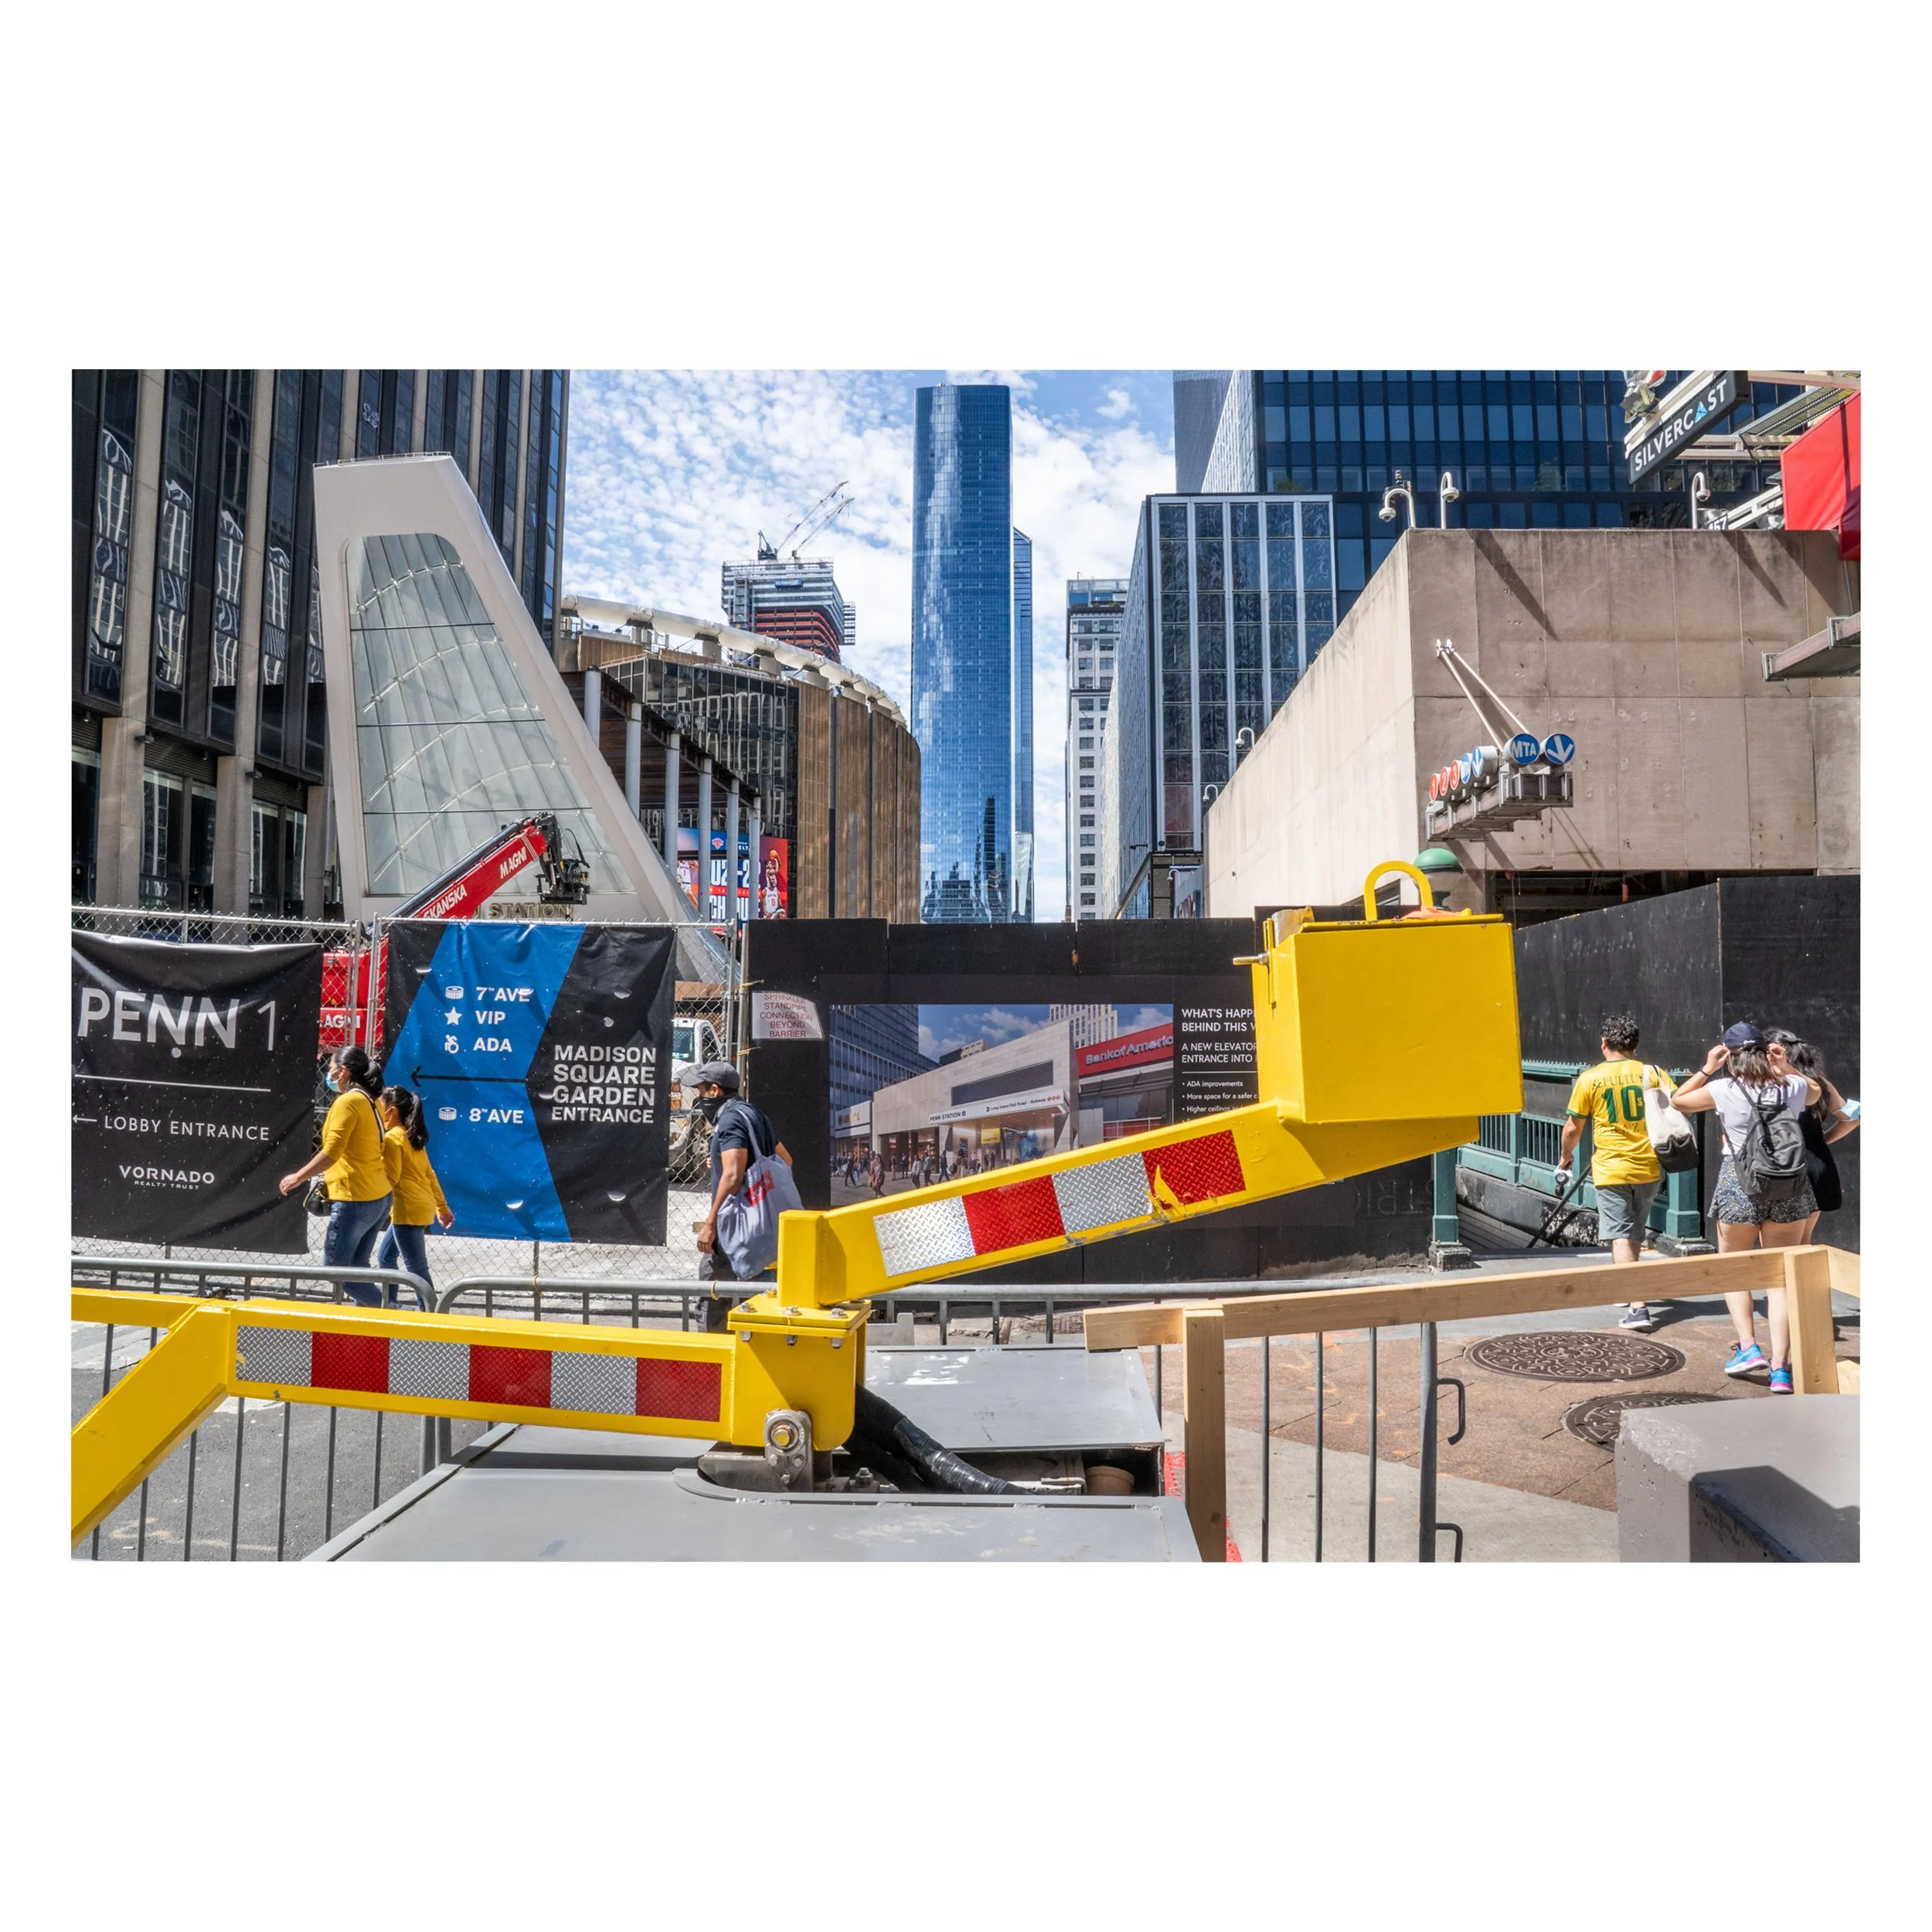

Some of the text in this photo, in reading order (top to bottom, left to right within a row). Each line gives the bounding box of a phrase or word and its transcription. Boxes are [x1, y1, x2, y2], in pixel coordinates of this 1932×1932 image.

[1634, 379, 1727, 472] SILVERCAST
[1512, 740, 1536, 758] MTA
[1452, 764, 1458, 787] 3
[500, 846, 528, 879] MAGNI
[422, 883, 468, 919] SKANSKA
[488, 902, 573, 918] STATION
[495, 988, 531, 1002] AVE
[764, 993, 806, 1005] SPRINKLER
[764, 1002, 807, 1011] STANDPIPE
[1182, 1009, 1255, 1018] WHAT'S HAPP
[77, 987, 276, 1051] PENN 1
[475, 1010, 506, 1025] VIP
[760, 1012, 813, 1021] CONNECTION
[1182, 1022, 1221, 1032] BEHIND
[1223, 1022, 1247, 1032] THIS
[473, 1038, 512, 1053] ADA
[1181, 1043, 1257, 1051] A NEW ELEVATOR
[554, 1045, 656, 1063] MADISON
[1182, 1054, 1229, 1063] ENTRANCE
[1231, 1054, 1253, 1063] INTO
[553, 1064, 655, 1085] SQUARE
[553, 1085, 655, 1106] GARDEN
[1601, 1085, 1645, 1124] 10
[488, 1109, 524, 1124] AVE
[551, 1106, 654, 1124] ENTRANCE
[942, 1111, 961, 1120] STATION
[104, 1115, 270, 1141] LOBBY ENTRANCE
[118, 1165, 215, 1185] VORNADO
[134, 1180, 166, 1189] REALTY
